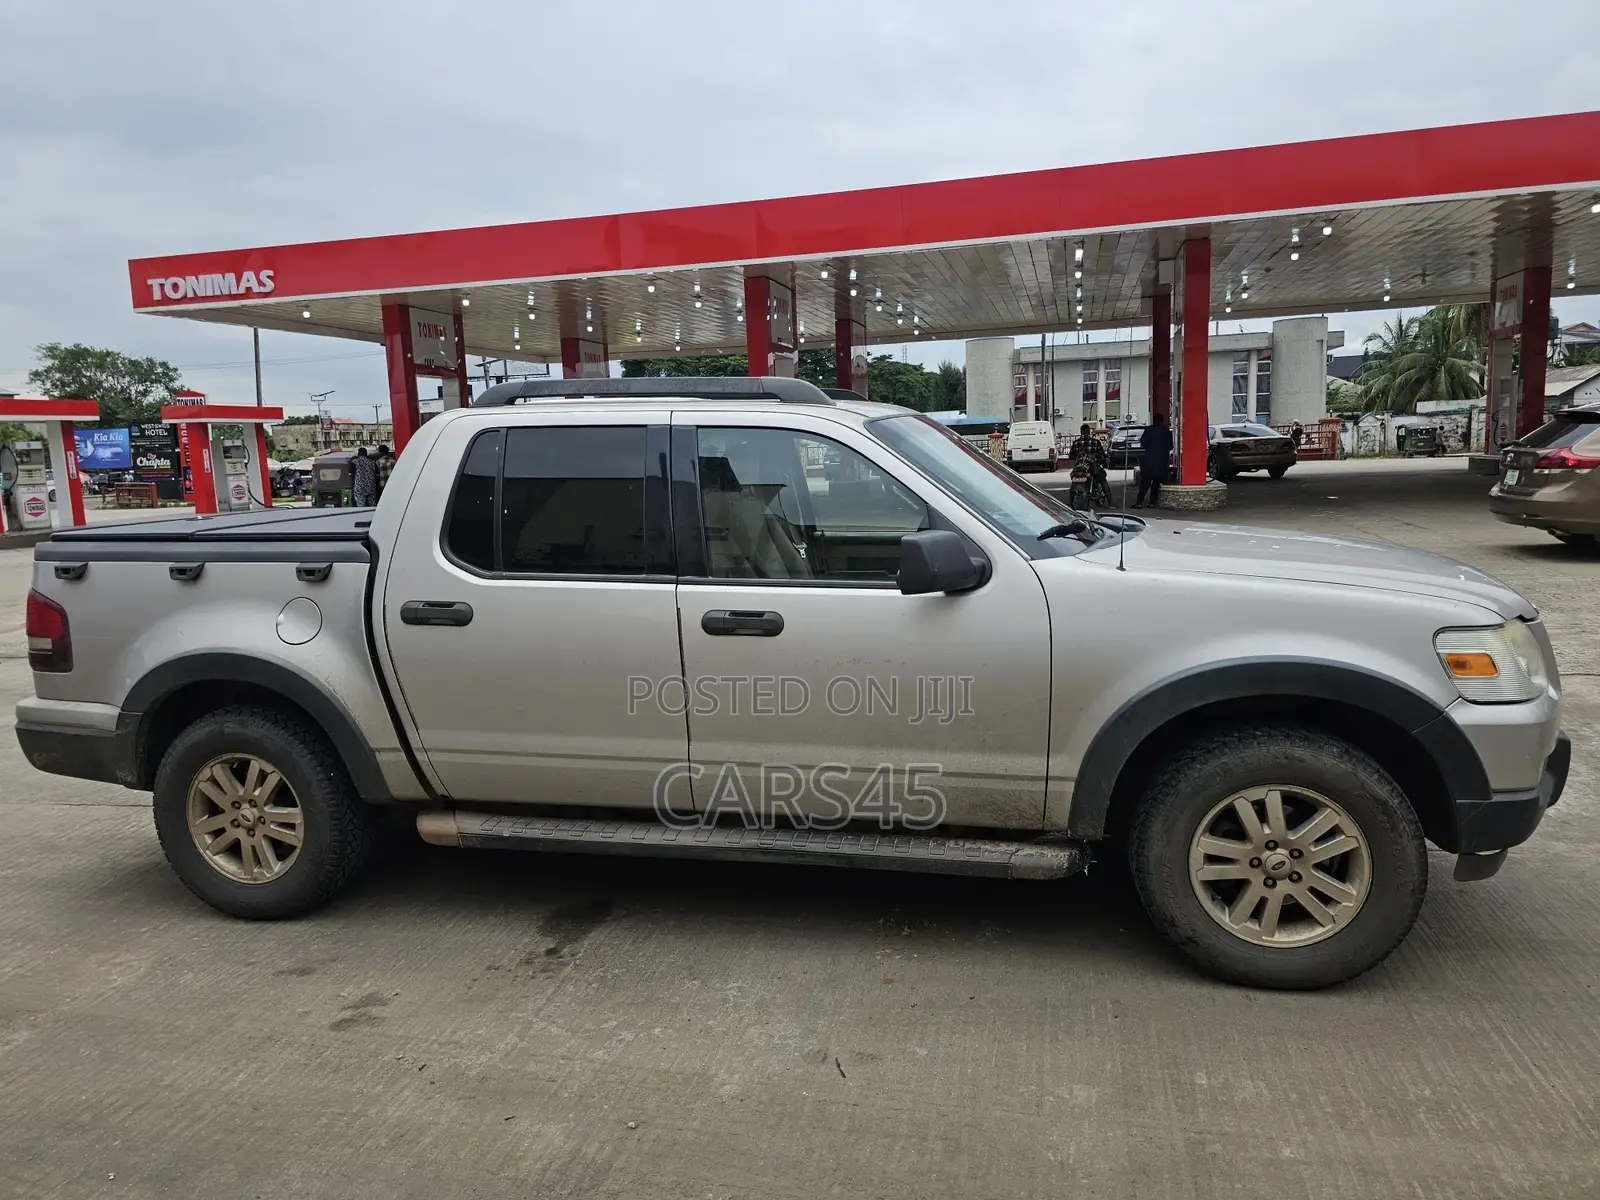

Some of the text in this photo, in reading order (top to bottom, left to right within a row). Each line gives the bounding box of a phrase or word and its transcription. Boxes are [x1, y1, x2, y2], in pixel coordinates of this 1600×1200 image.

[146, 269, 276, 301] TONIMAS
[94, 432, 124, 442] Kia Kia
